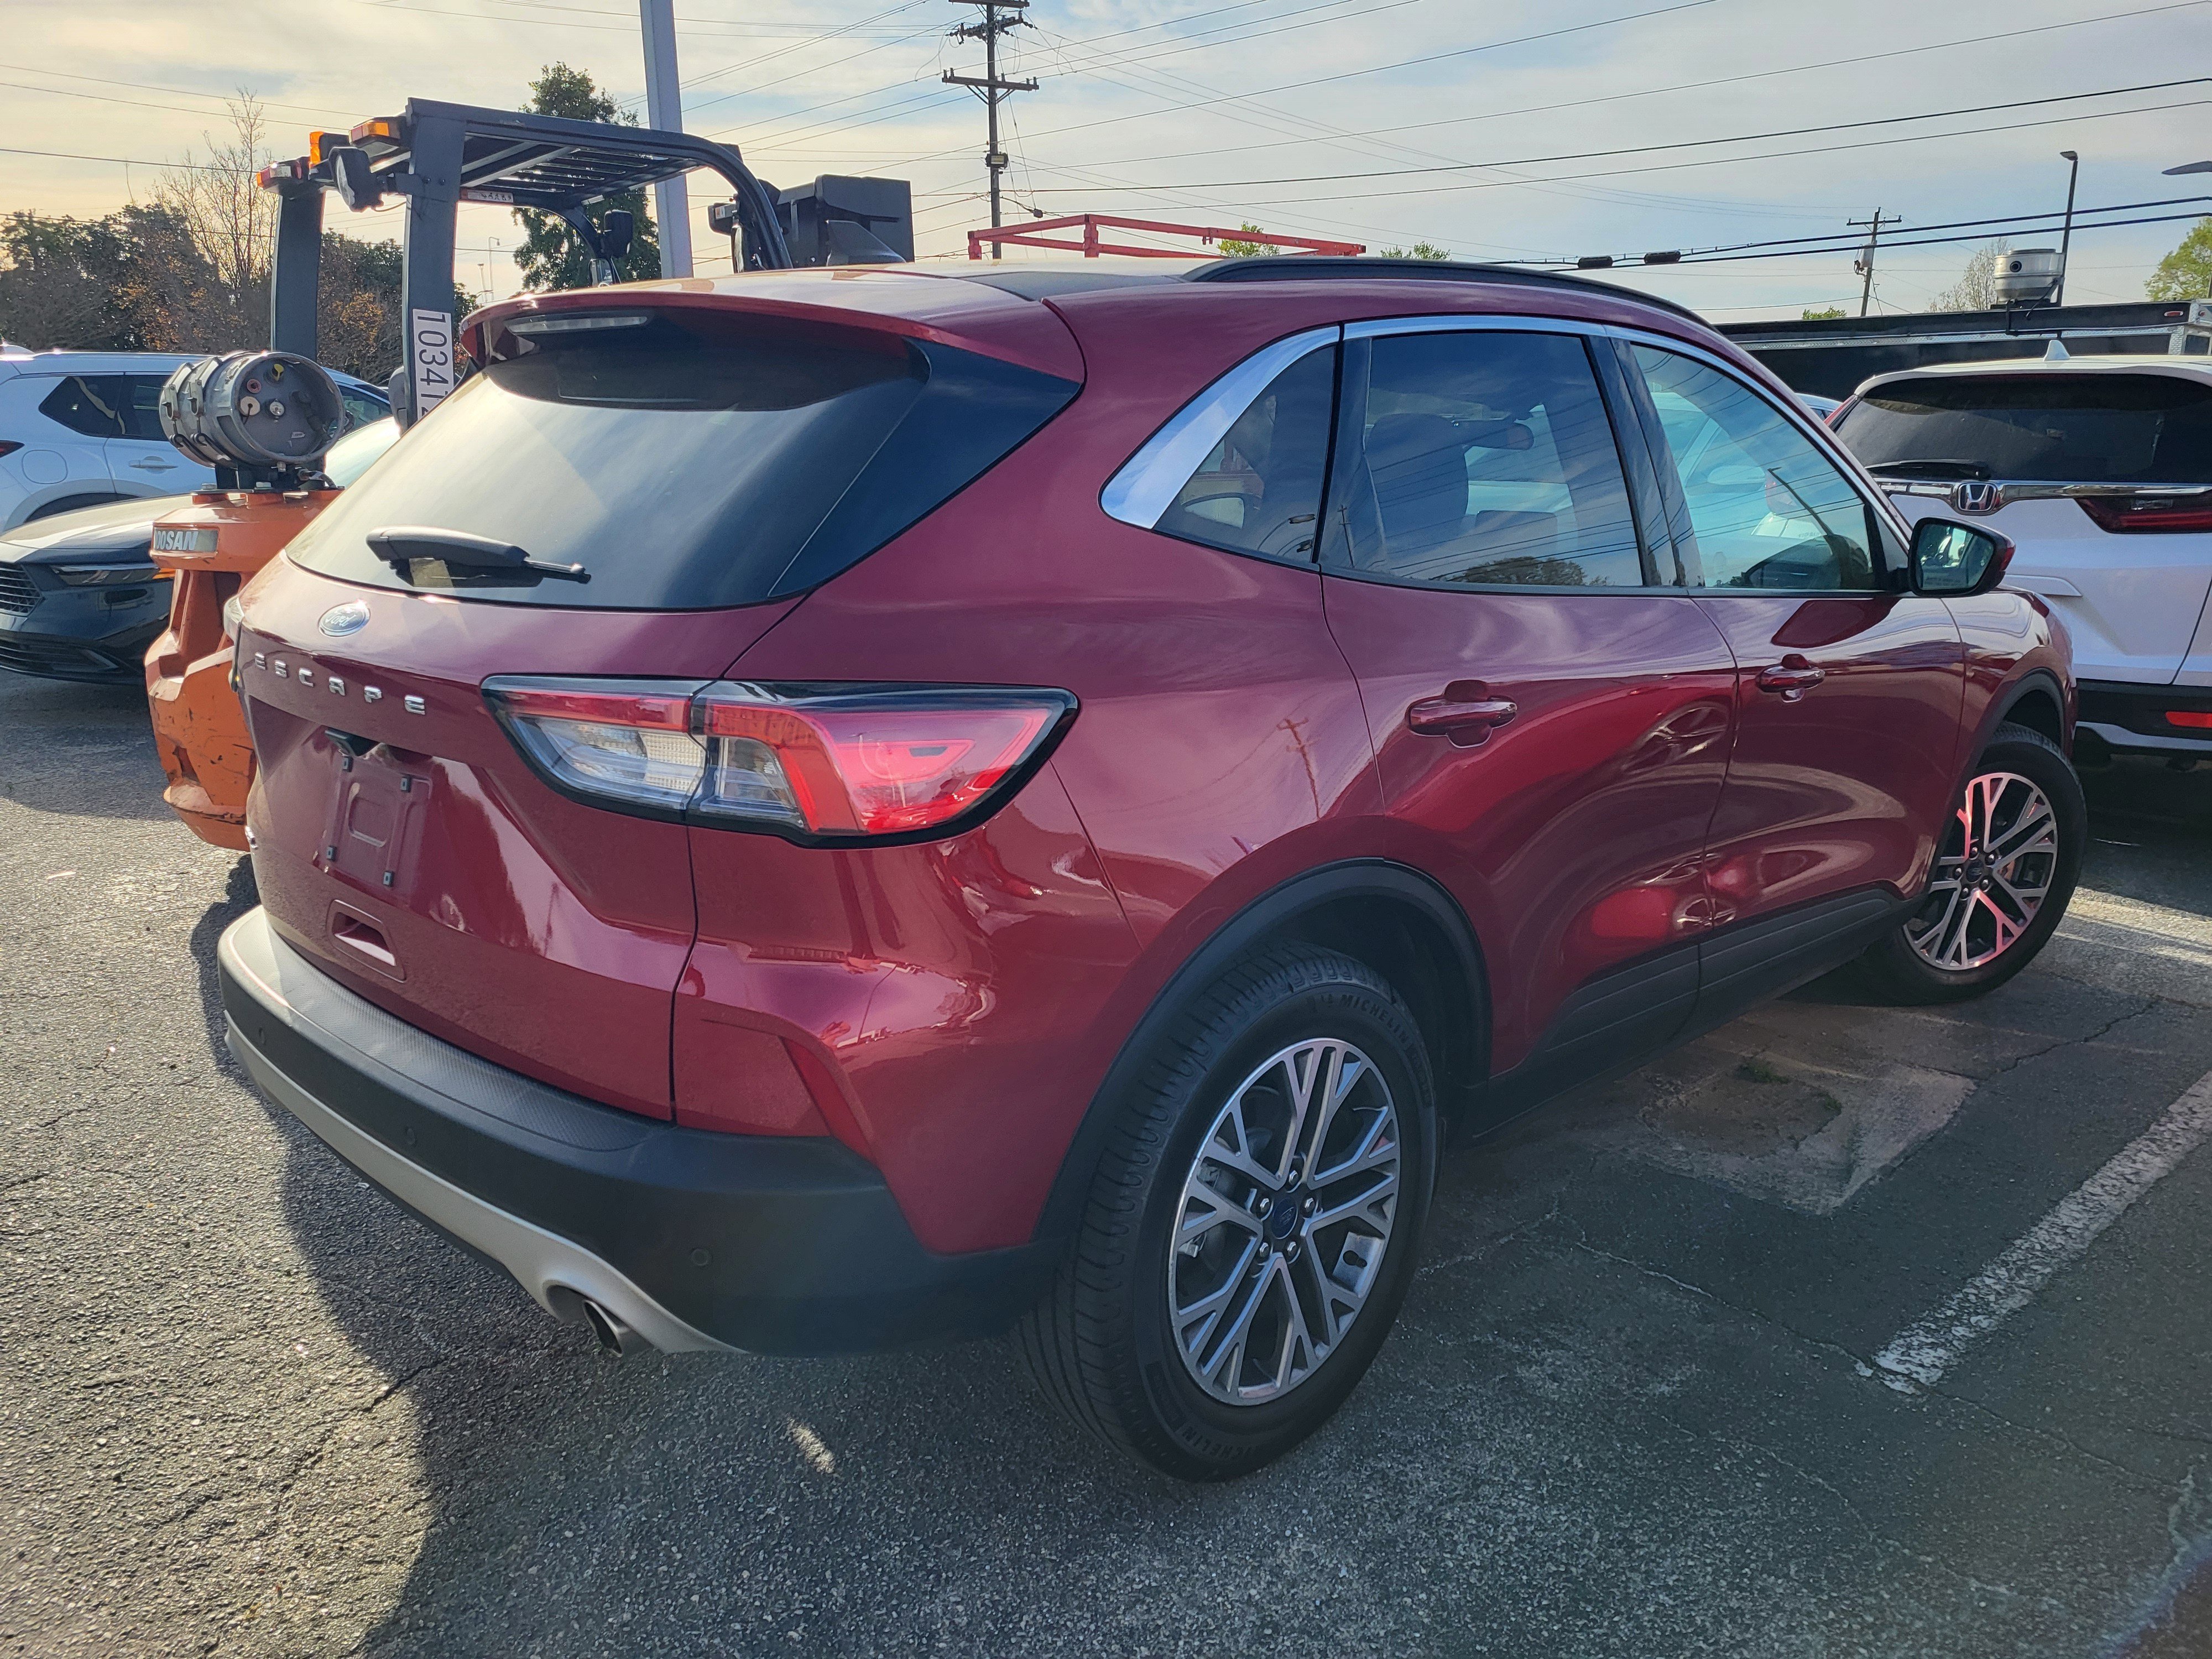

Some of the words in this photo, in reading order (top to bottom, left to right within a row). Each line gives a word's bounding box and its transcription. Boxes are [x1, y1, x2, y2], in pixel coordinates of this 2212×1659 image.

[255, 652, 425, 715] ESCAPE
[1340, 994, 1410, 1045] MICHELIN
[1182, 1426, 1254, 1462] ICHELIN
